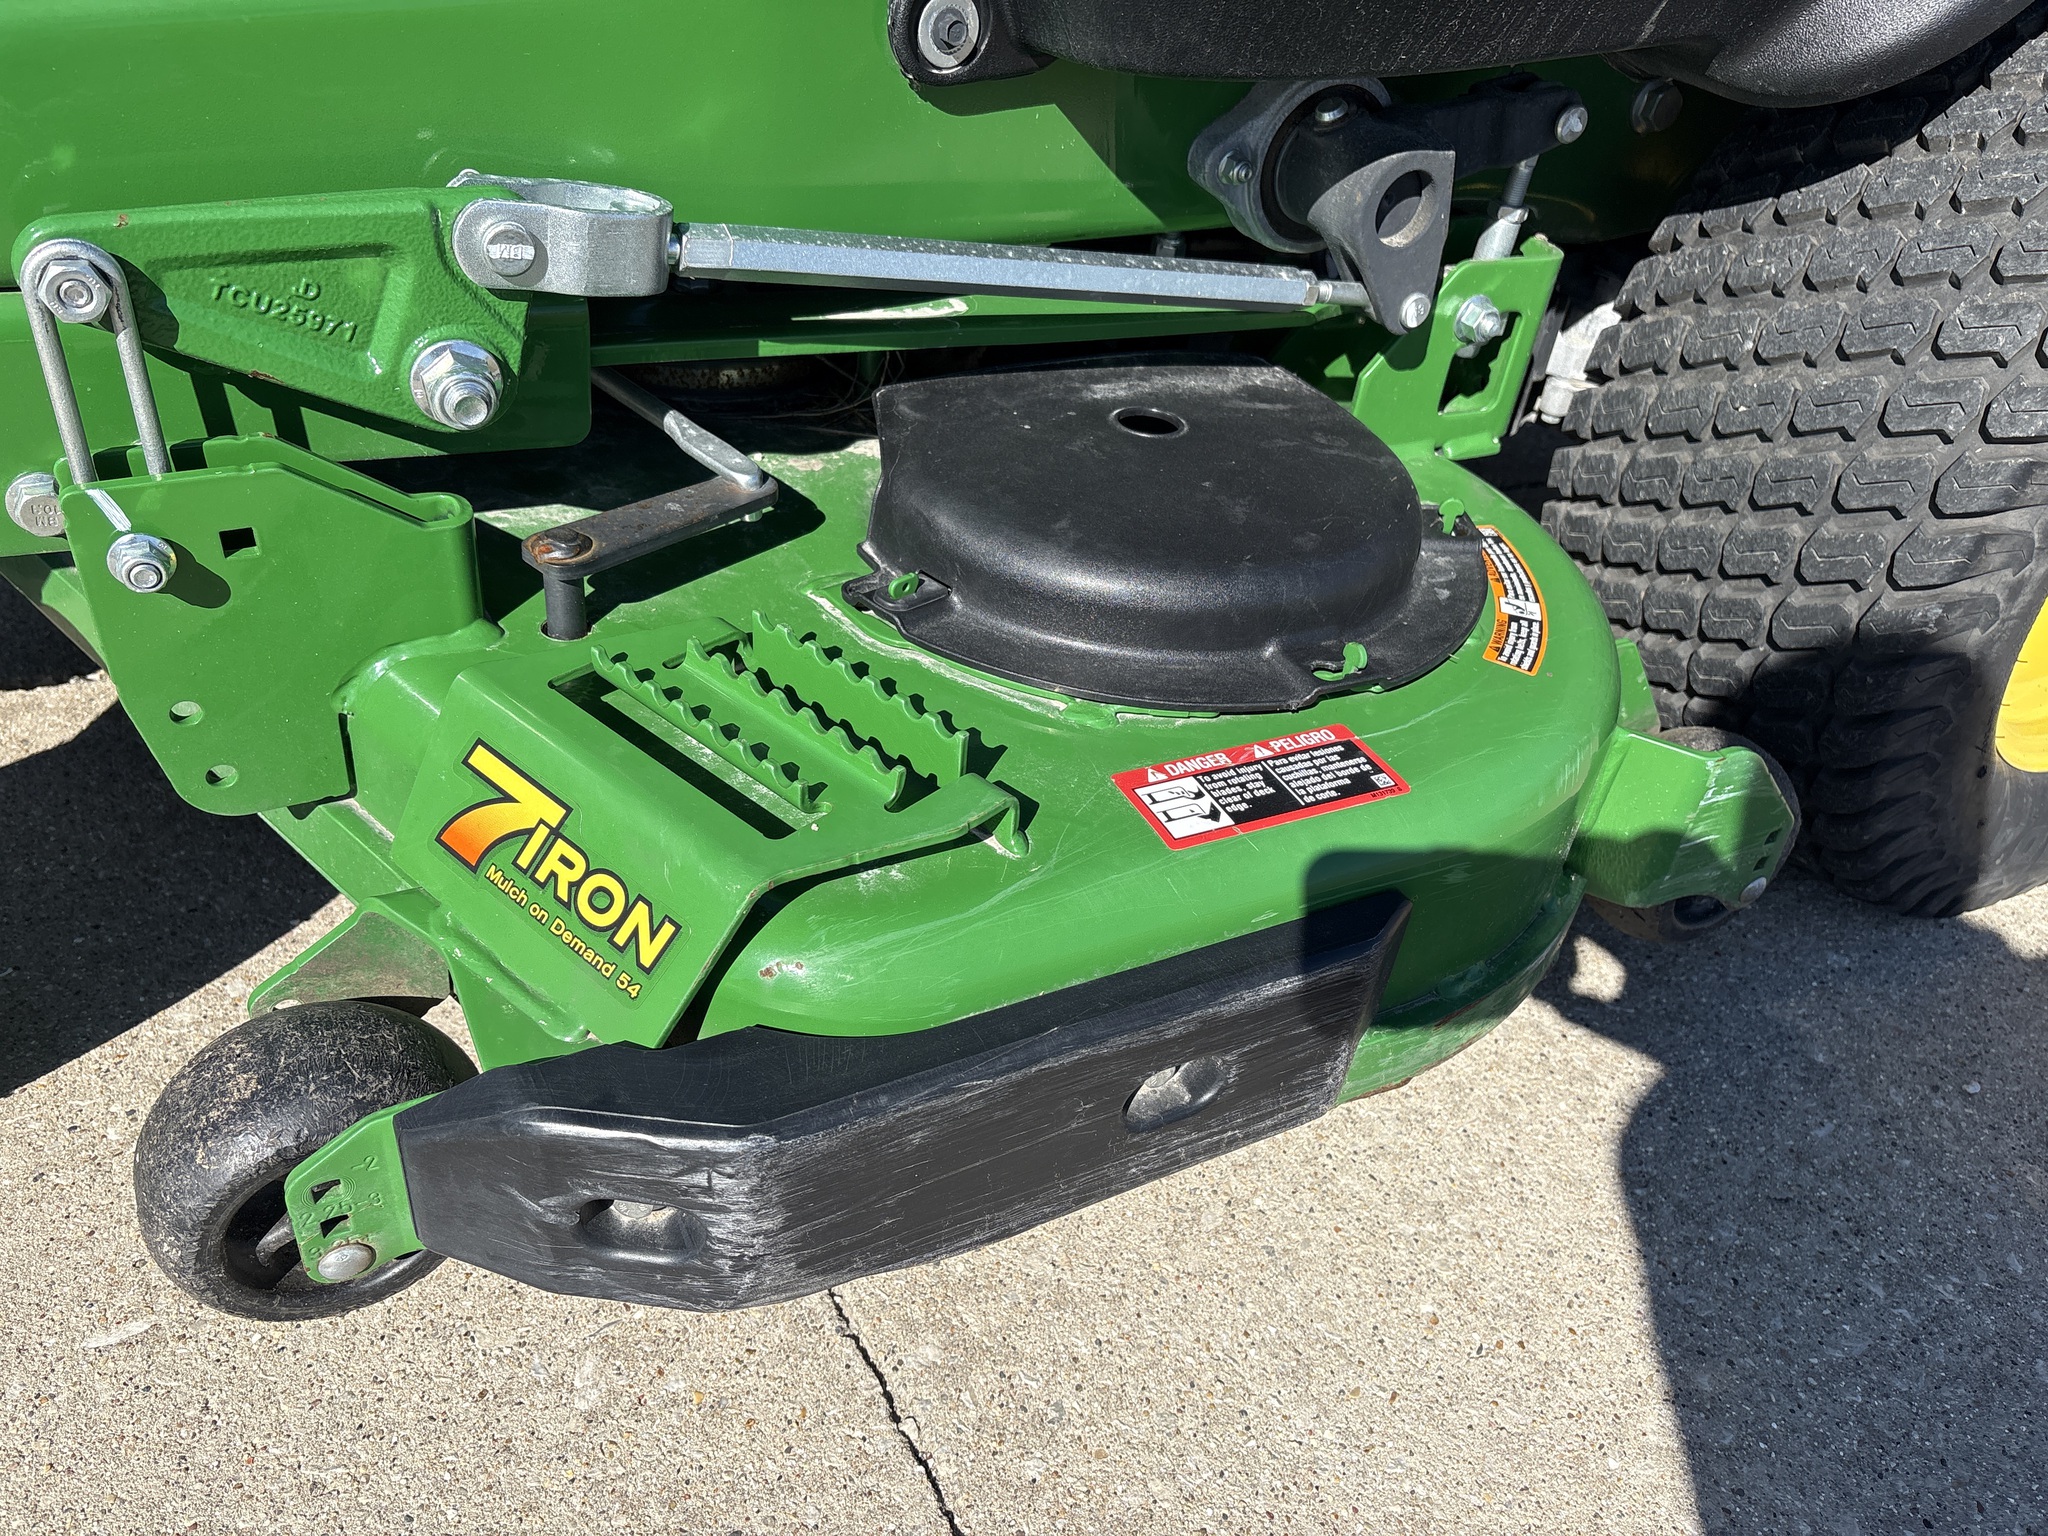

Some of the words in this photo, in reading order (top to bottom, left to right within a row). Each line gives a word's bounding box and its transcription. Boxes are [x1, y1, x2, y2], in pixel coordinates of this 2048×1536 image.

[1269, 729, 1336, 752] PELIGRO
[1164, 752, 1232, 776] DANGER
[1267, 757, 1289, 768] Para
[1289, 751, 1311, 763] evitar
[1310, 745, 1345, 758] lesiones
[1274, 761, 1313, 774] causadas
[1314, 758, 1328, 768] por
[1328, 753, 1341, 762] las
[1197, 775, 1211, 783] To
[1213, 768, 1237, 780] avoid
[1237, 763, 1263, 775] injury
[1282, 767, 1322, 781] cuchillas,
[1321, 756, 1368, 772] mantenerse
[1288, 776, 1322, 789] alejado
[1322, 772, 1337, 781] del
[1337, 767, 1361, 778] borde
[1361, 763, 1373, 772] de
[1205, 782, 1228, 791] from
[1228, 772, 1263, 786] rotating
[1210, 786, 1246, 798] blades,
[1247, 780, 1266, 791] stay
[1295, 788, 1306, 796] la
[1306, 777, 1351, 795] plataforma
[1218, 794, 1242, 805] clear
[1243, 791, 1254, 800] of
[1254, 786, 1276, 797] deck
[1302, 794, 1316, 803] de
[1316, 790, 1341, 802] corte.
[1226, 803, 1252, 813] edge.
[435, 737, 573, 874] 7
[511, 817, 682, 975] IRON
[485, 863, 529, 907] Mulch
[529, 901, 549, 925] on
[549, 917, 617, 980] Demand
[615, 971, 643, 1000] 54
